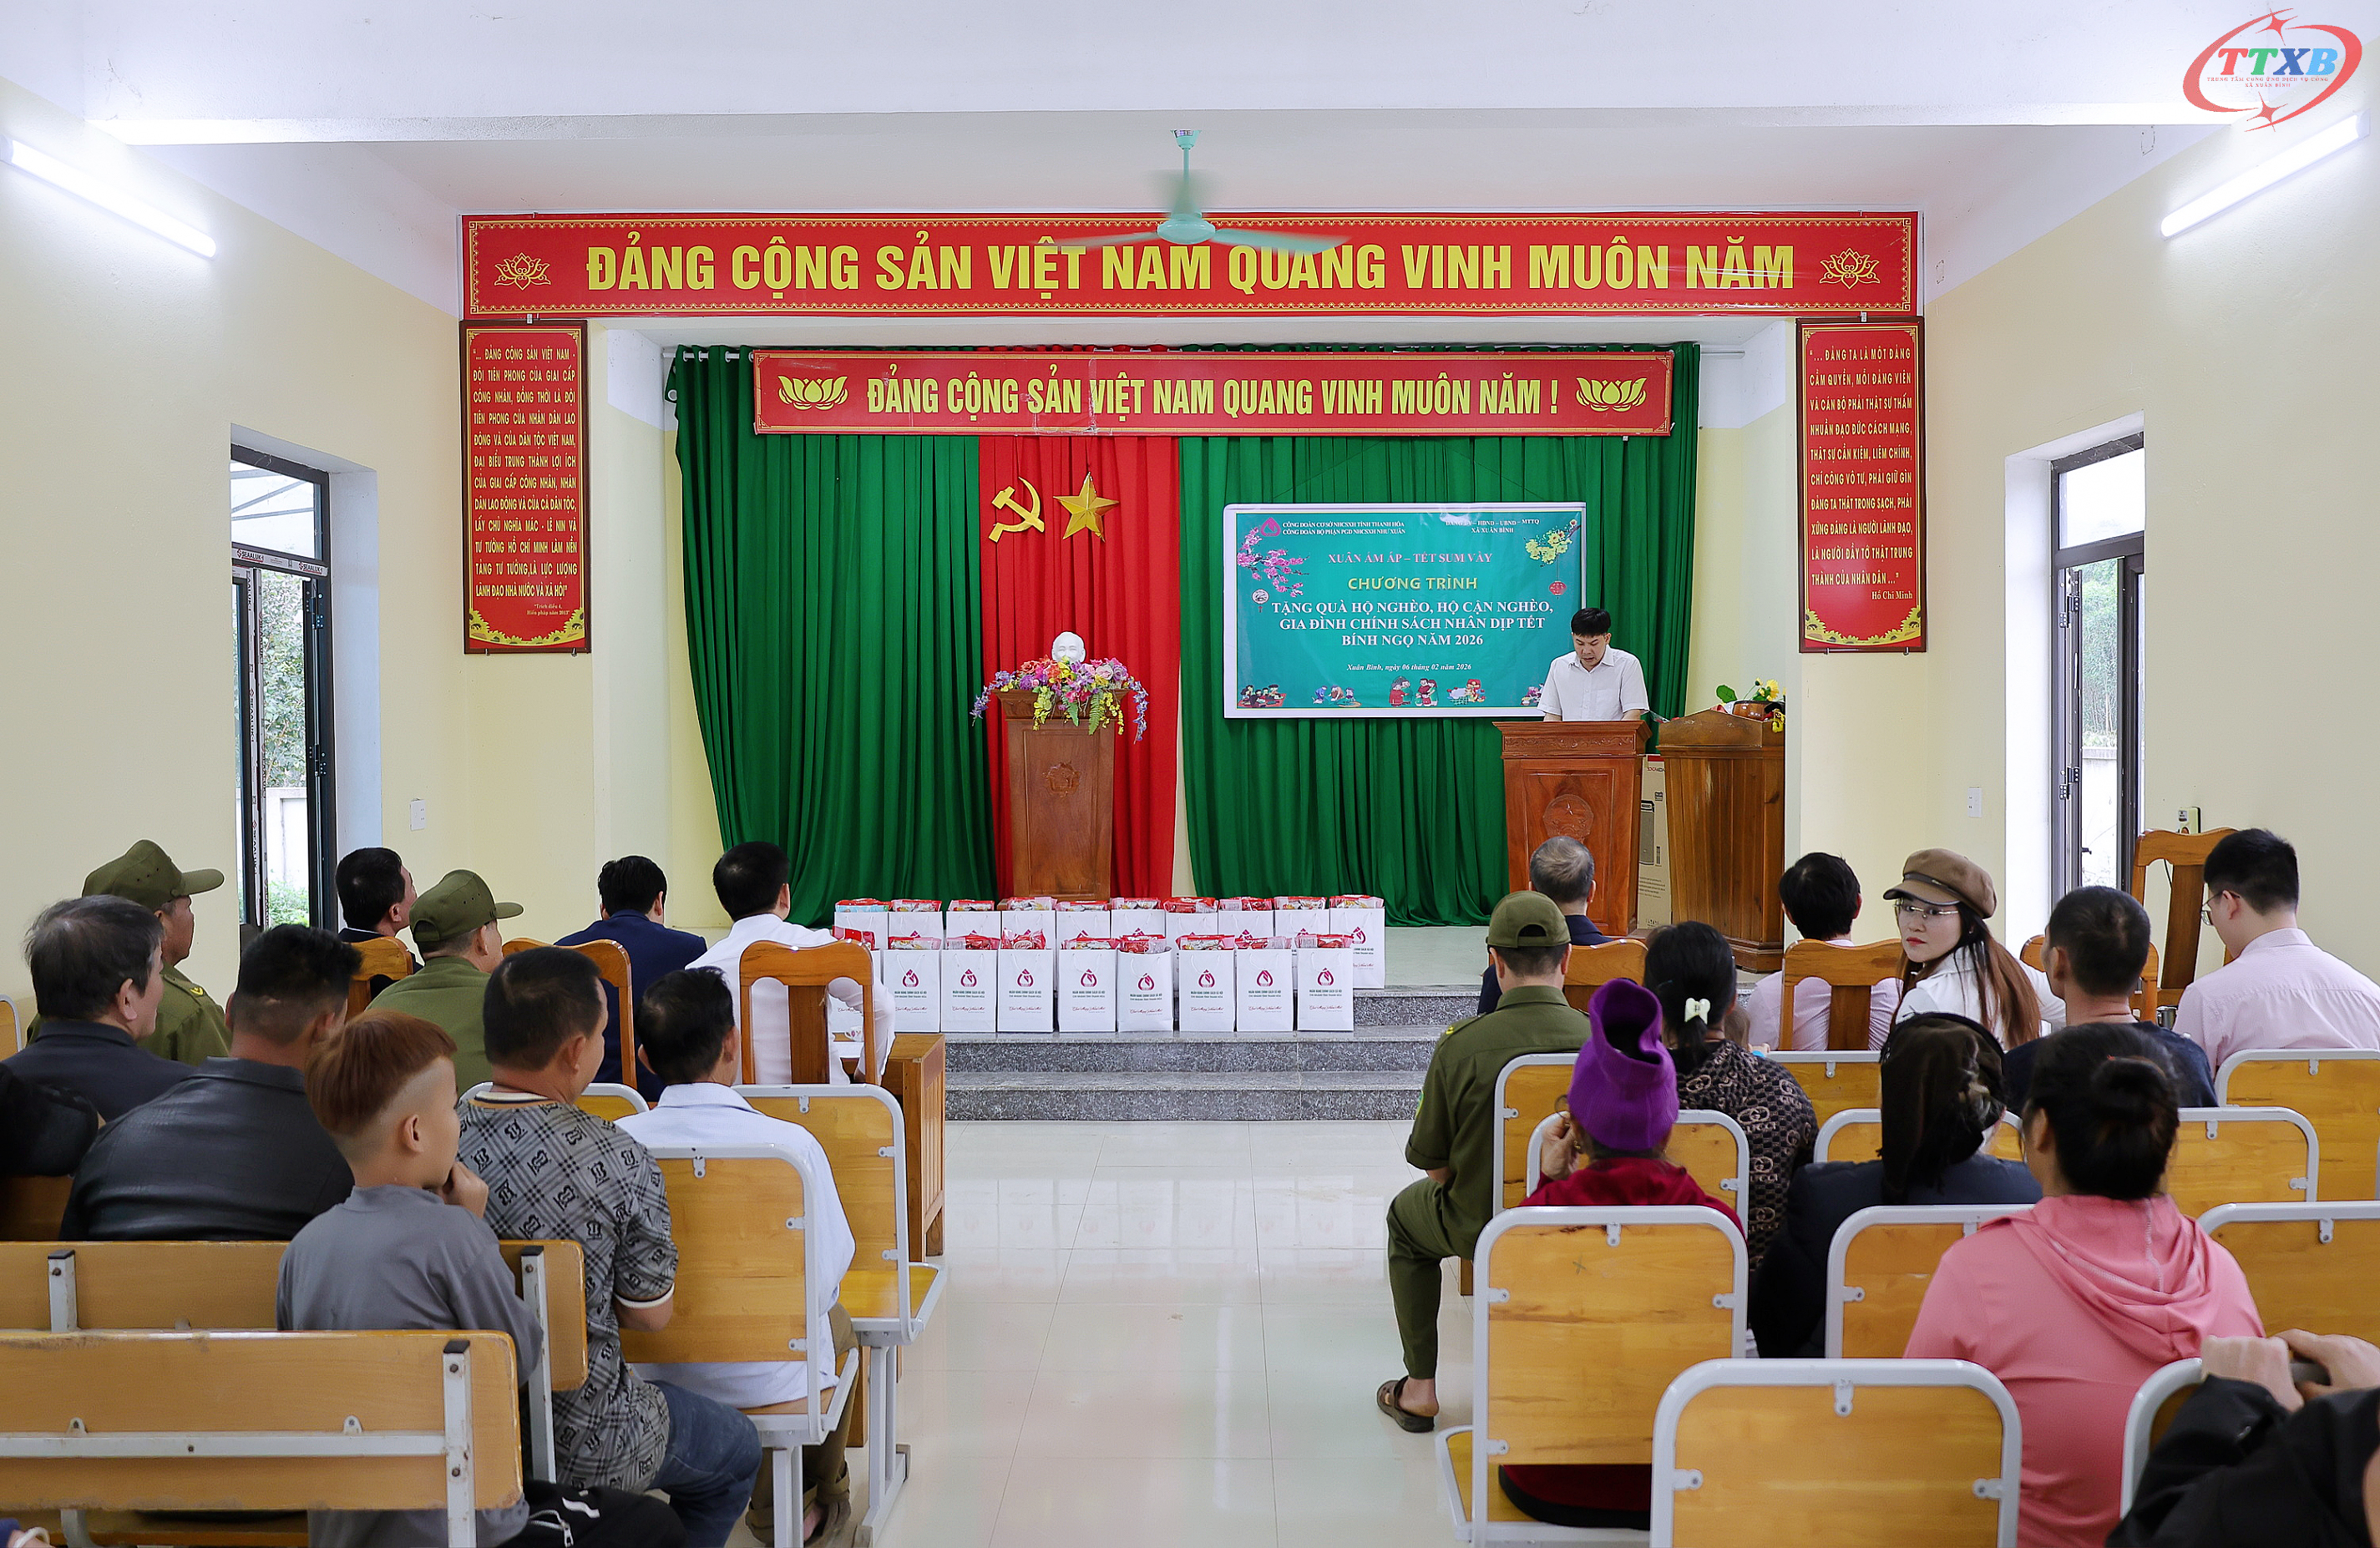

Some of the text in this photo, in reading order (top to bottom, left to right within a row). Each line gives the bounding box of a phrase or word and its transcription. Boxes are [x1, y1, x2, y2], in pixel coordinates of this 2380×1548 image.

[586, 230, 1793, 299] ĐẢNG CỘNG SẢN VIỆT NAM QUANG VINH MUÔN NĂM
[485, 345, 501, 360] ĐẢNG
[505, 346, 523, 363] CỘNG
[527, 345, 538, 360] SẢN
[542, 346, 553, 363] VIỆT
[557, 349, 569, 360] NAM
[1826, 346, 1846, 361] ĐẢNG
[1849, 350, 1856, 360] TA
[1861, 347, 1868, 360] LÀ
[1871, 346, 1886, 362] MỘT
[1890, 345, 1910, 359] ĐẢNG
[473, 365, 575, 384] ĐỘI TIÊN PHONG CỦA GIAI CẤP
[1810, 368, 1911, 387] CẦM QUYỀN, MỖI ĐẢNG VIÊN
[473, 386, 575, 406] CÔNG NHÂN, ĐỒNG THỜI LÀ ĐỘI
[868, 364, 938, 412] ĐẢNG
[948, 373, 1018, 421] CỘNG
[1028, 364, 1081, 413] SẢN
[1090, 373, 1143, 421] VIỆT
[1155, 380, 1213, 413] NAM
[1223, 380, 1312, 417] QUANG
[1321, 380, 1382, 413] VINH
[1392, 372, 1470, 414] MUÔN
[1480, 372, 1540, 413] NĂM
[1810, 392, 1912, 413] VÀ CÁN BỘ PHẢI THẬT SỰ THẤM
[474, 409, 575, 424] TIÊN PHONG CỦA NHÂN DÂN LAO
[1810, 418, 1912, 438] NHUẦN ĐẠO ĐỨC CÁCH MẠNG,
[474, 430, 575, 449] ĐỘNG VÀ CỦA DÂN TỘC VIỆT NAM,
[1349, 575, 1477, 589] CHƯƠNG TRÌNH
[1872, 590, 1881, 599] Hồ
[1883, 591, 1894, 599] Chí
[1272, 599, 1553, 615] TẶNG QUÀ HỘ NGHÈO, HỘ CẬN NGHÈO,
[1280, 619, 1306, 630] GIA
[1309, 616, 1346, 629] ĐÌNH
[1350, 616, 1398, 629] CHÍNH
[1402, 615, 1441, 629] SÁCH
[1445, 615, 1486, 629] NHÂN
[1491, 618, 1514, 631] DỊP
[1343, 634, 1483, 648] BÍNH NGỌ NĂM 2026
